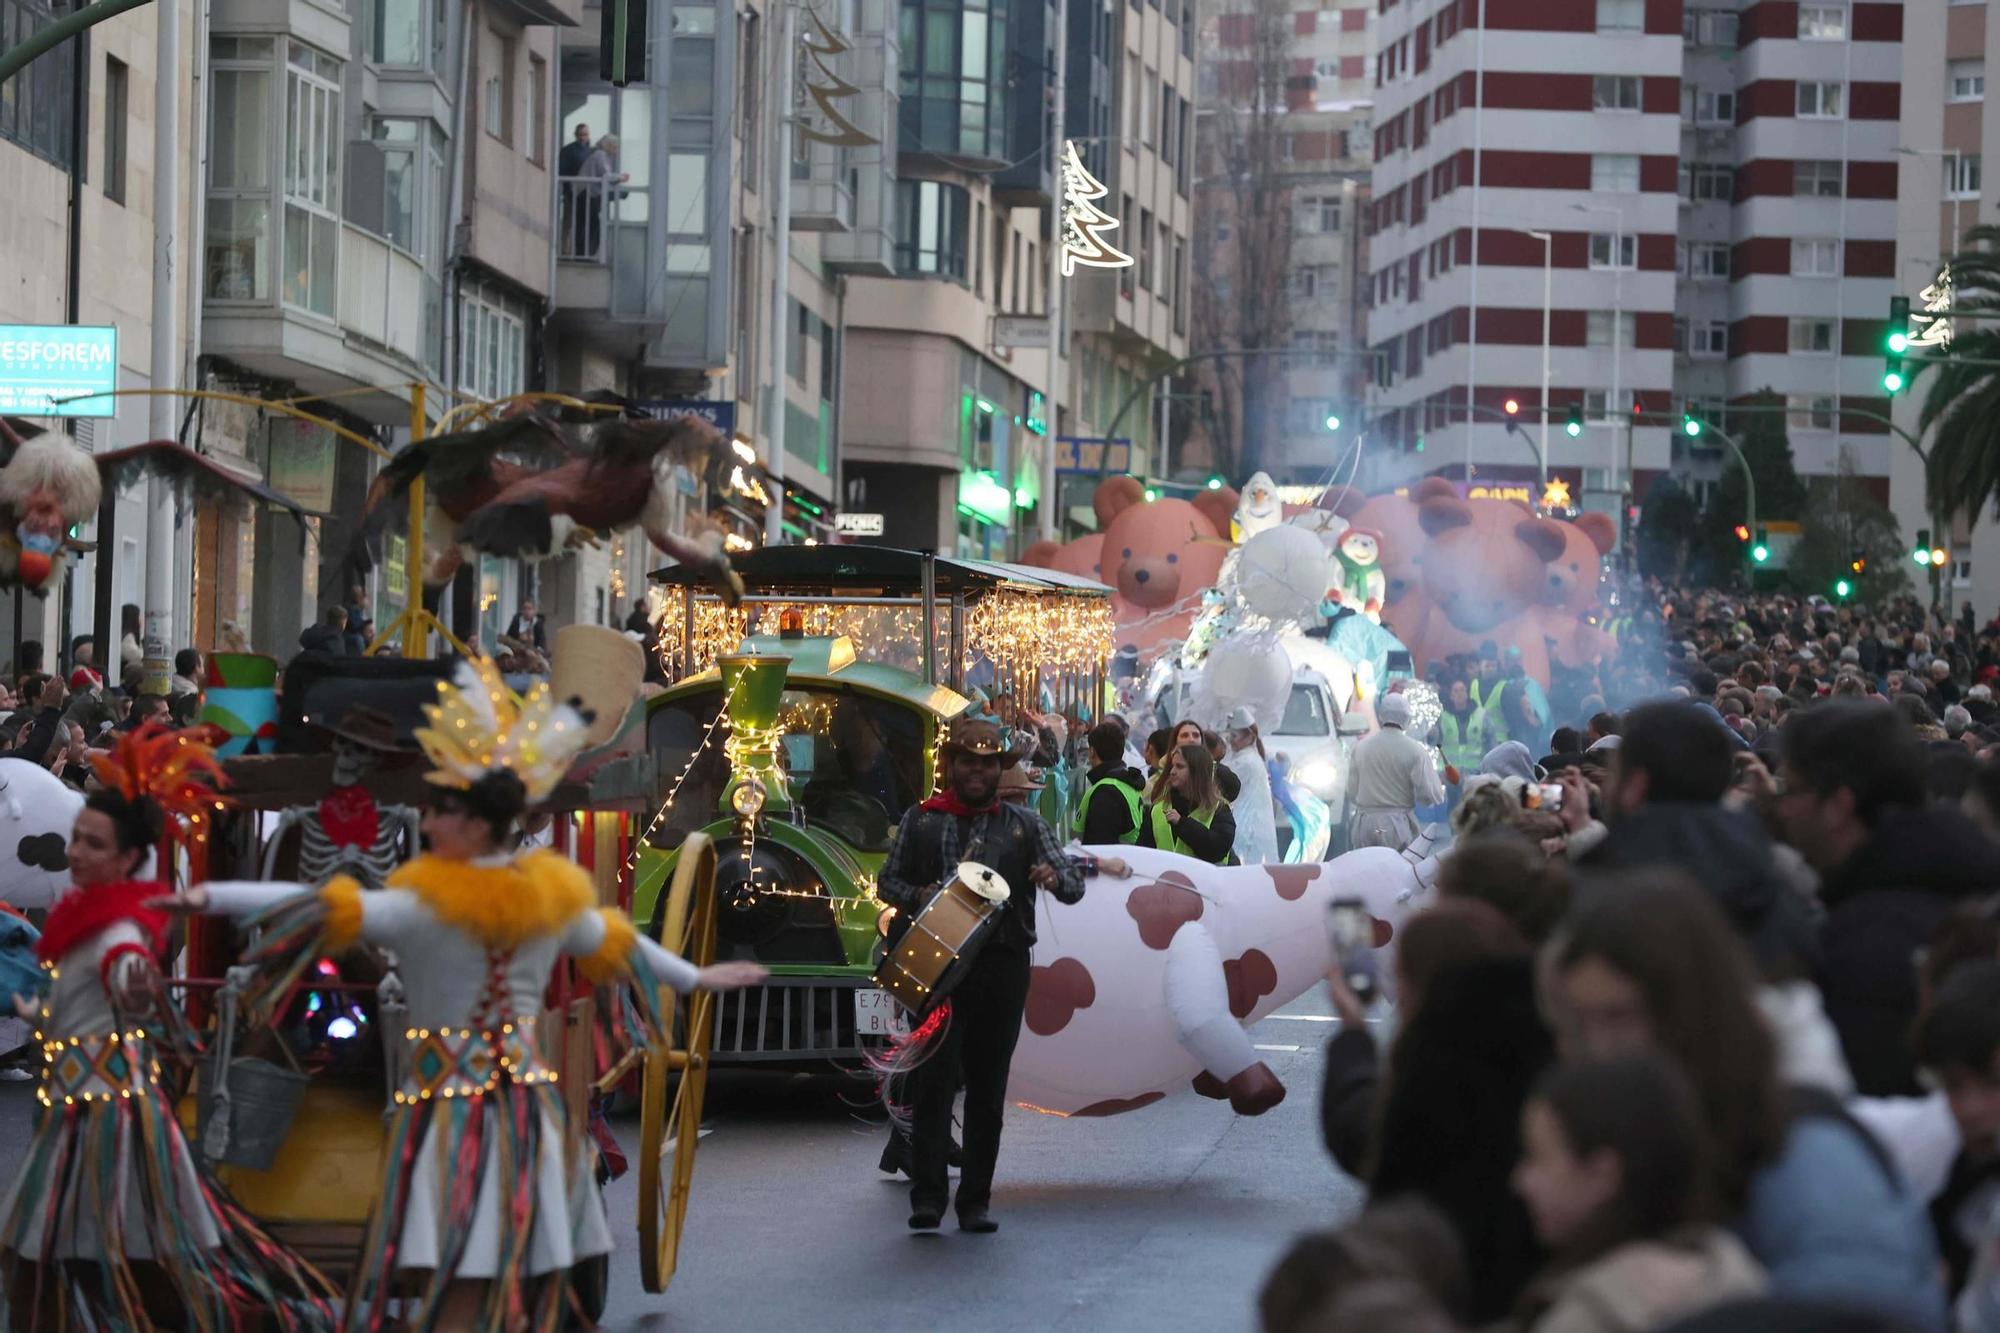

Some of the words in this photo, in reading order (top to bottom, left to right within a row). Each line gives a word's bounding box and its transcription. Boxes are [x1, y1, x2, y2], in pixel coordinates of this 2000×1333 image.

[0, 341, 111, 364] ESFOREM
[860, 993, 869, 1008] E
[871, 1015, 904, 1031] BC
